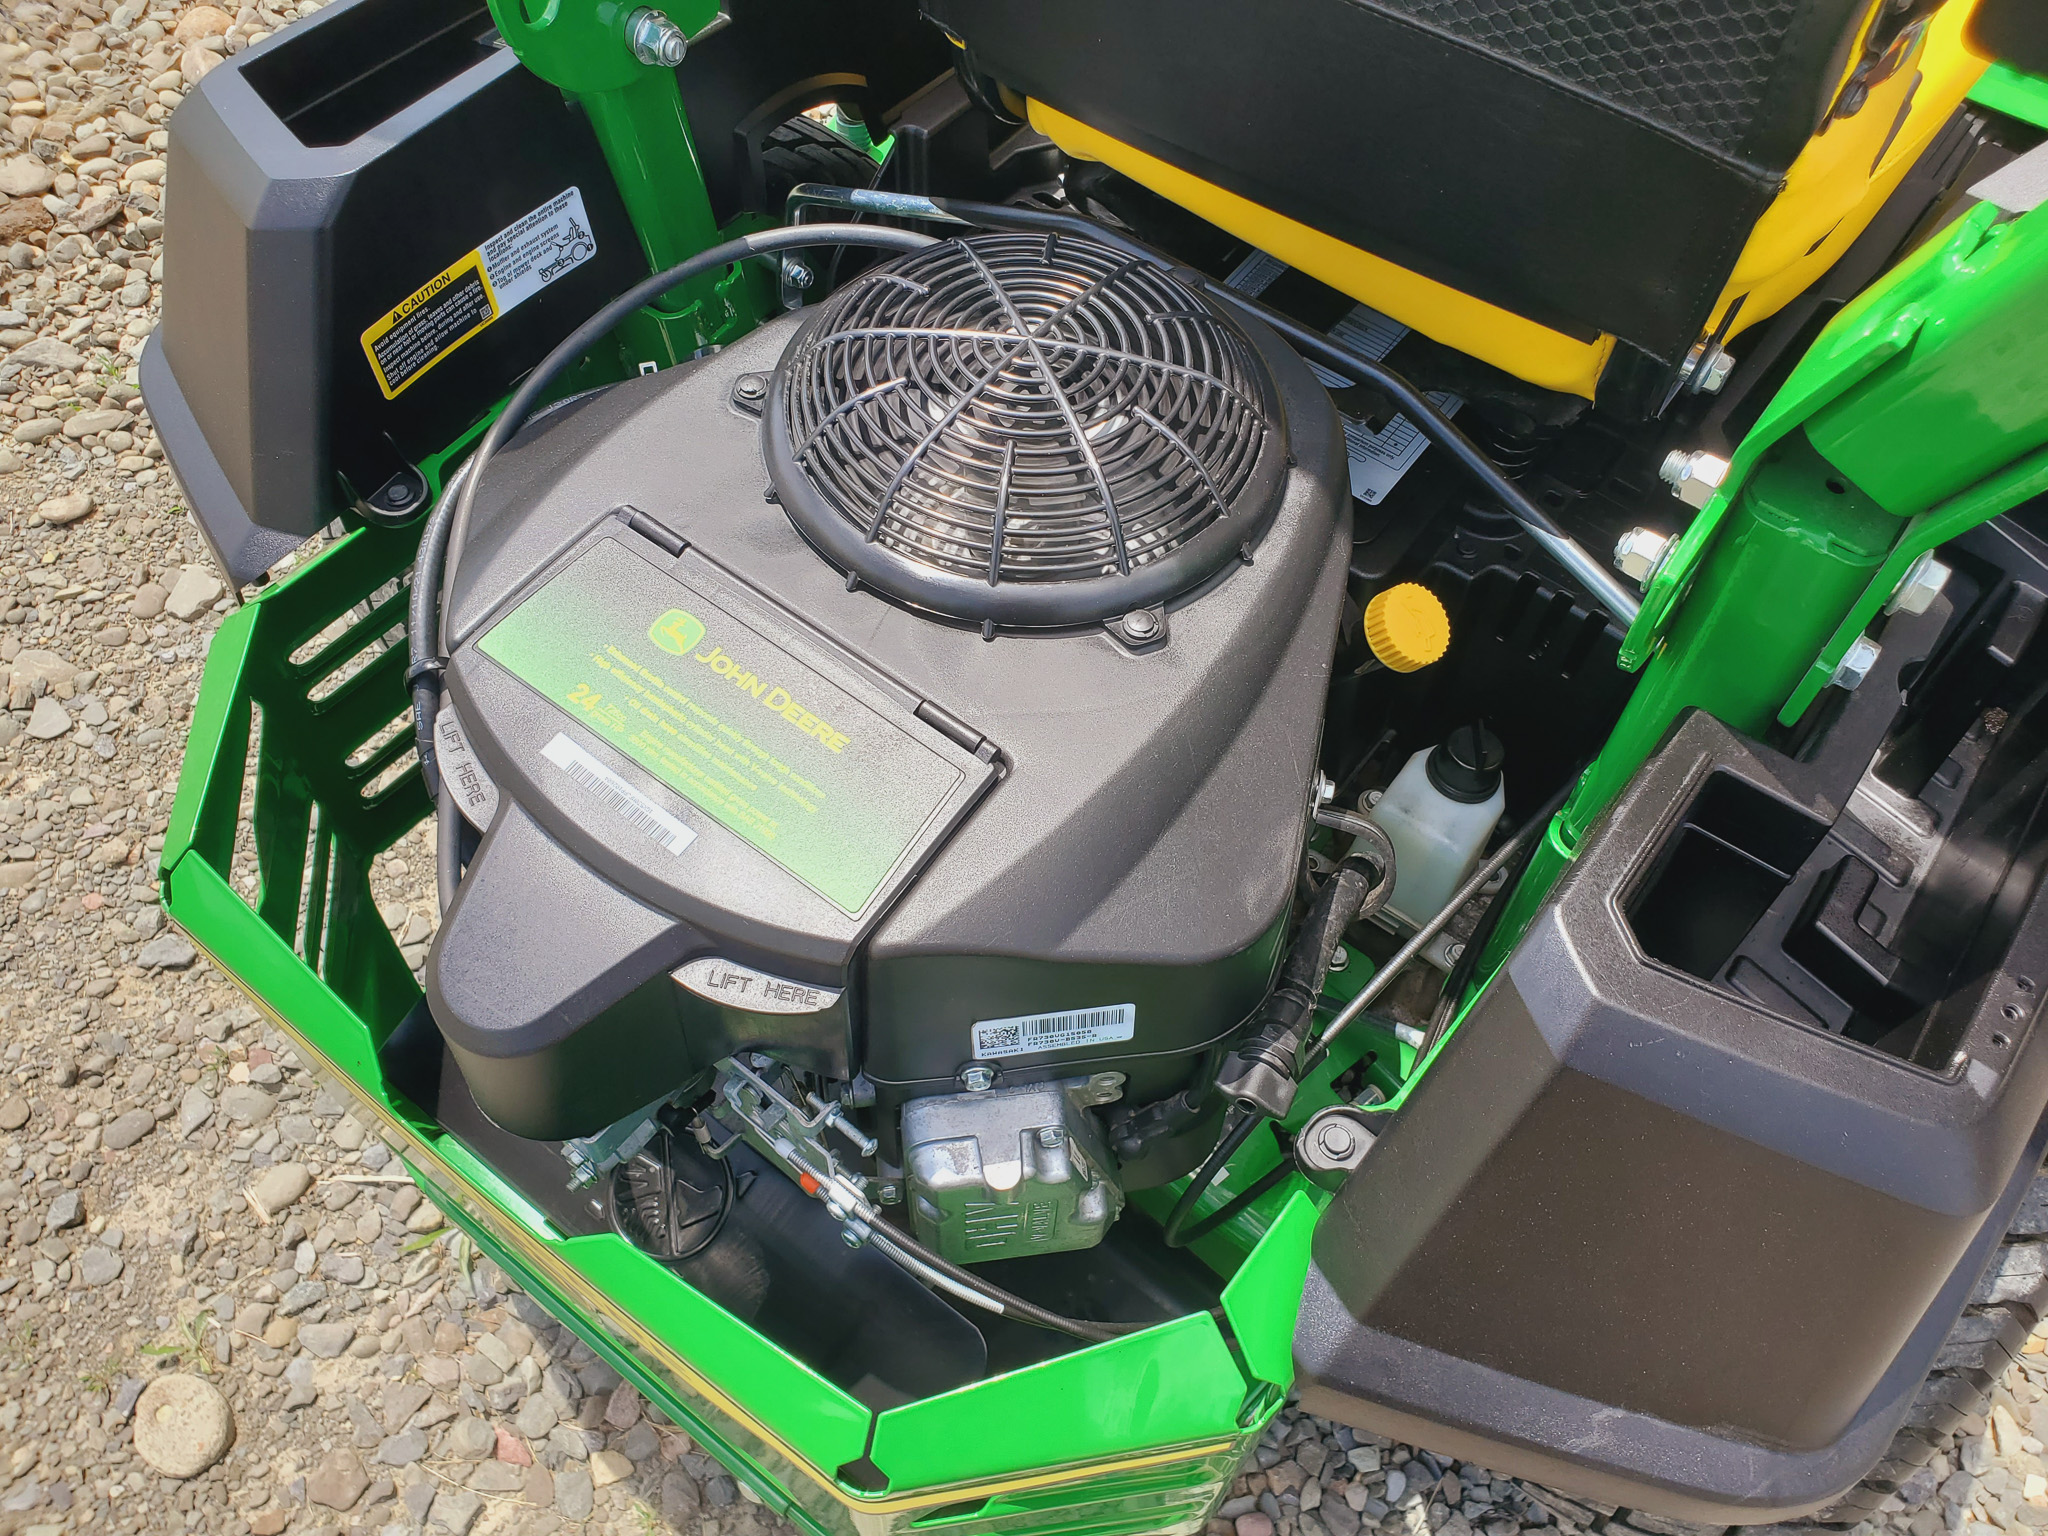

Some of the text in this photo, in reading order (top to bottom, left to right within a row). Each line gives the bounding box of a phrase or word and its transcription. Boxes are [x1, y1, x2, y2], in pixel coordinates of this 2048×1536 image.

[484, 190, 574, 251] Inspect and clean the entire machine
[486, 246, 497, 257] and
[496, 241, 507, 251] pay
[506, 227, 526, 244] special
[525, 214, 548, 231] attention
[553, 201, 568, 213] these
[491, 254, 510, 270] Muffler
[510, 247, 520, 258] and
[520, 234, 541, 251] exhaust
[540, 224, 559, 239] system
[494, 262, 512, 277] Engine
[512, 255, 522, 266] and
[522, 244, 540, 259] engine
[539, 232, 560, 248] screens
[496, 275, 508, 284] Top
[506, 270, 513, 278] of
[512, 259, 530, 274] mower
[530, 251, 543, 263] deck
[543, 244, 553, 255] and
[402, 272, 451, 314] CAUTION
[499, 264, 532, 290] under shields
[374, 306, 431, 352] Avoid equipment fires.
[377, 333, 409, 360] Accumulation
[408, 327, 414, 336] of
[427, 305, 444, 320] leaves
[442, 298, 453, 309] and
[452, 290, 465, 302] other
[464, 279, 480, 293] debris
[380, 357, 388, 366] on
[386, 352, 393, 360] or
[392, 344, 404, 356] near
[402, 337, 412, 347] hot
[411, 333, 417, 341] or
[416, 320, 435, 336] moving
[433, 311, 446, 324] parts
[445, 304, 455, 314] can
[454, 294, 469, 307] cause
[472, 285, 482, 294] fire.
[383, 355, 401, 373] Inspect
[400, 340, 421, 359] machine
[437, 315, 454, 330] during
[452, 307, 463, 319] and
[462, 300, 474, 312] after
[473, 293, 484, 303] use.
[386, 367, 400, 381] Shut
[399, 361, 407, 371] off
[406, 348, 424, 365] engine
[424, 338, 435, 351] and
[434, 329, 449, 343] allow
[448, 312, 471, 331] machine
[389, 344, 439, 386] cool before cleaning.
[567, 682, 603, 714] 24
[694, 646, 852, 754] JOHN DEERE
[440, 721, 486, 807] LIFT HERE
[707, 969, 820, 1006] LIFT HERE
[981, 1047, 1024, 1057] KAWASAKI
[1038, 1040, 1081, 1050] ASSEMBLED
